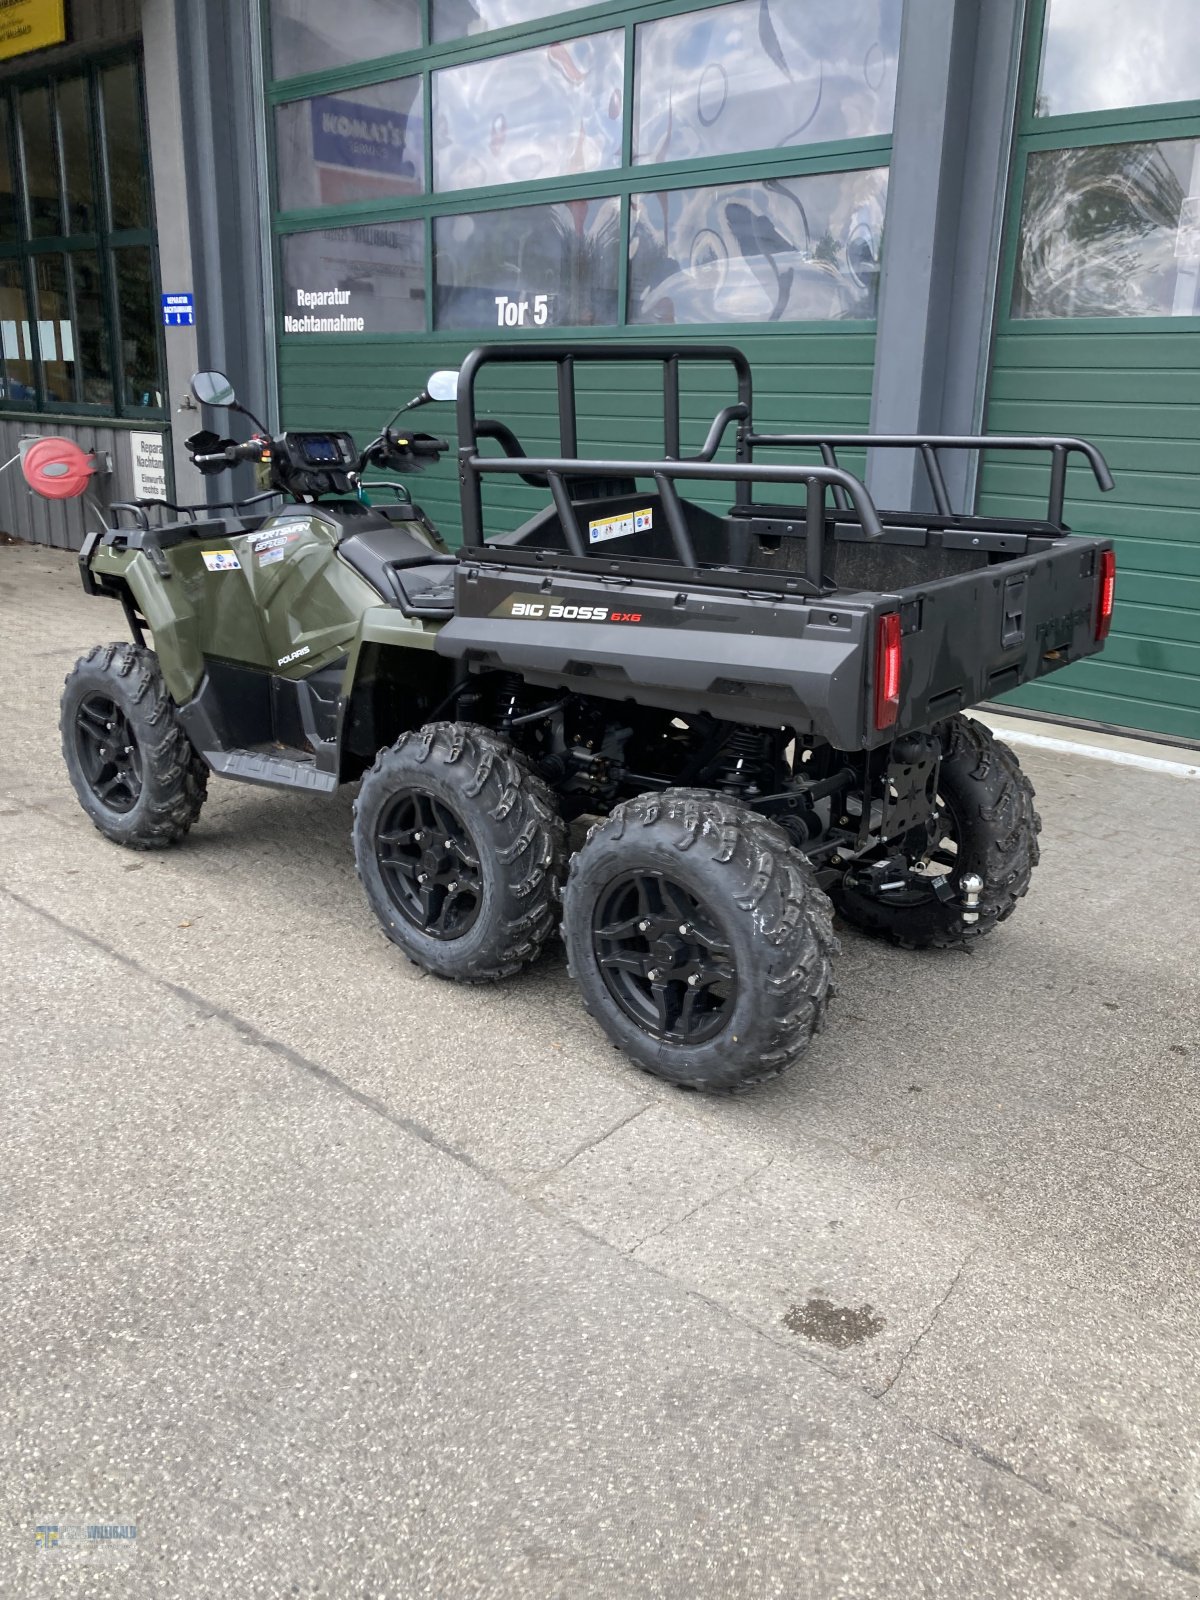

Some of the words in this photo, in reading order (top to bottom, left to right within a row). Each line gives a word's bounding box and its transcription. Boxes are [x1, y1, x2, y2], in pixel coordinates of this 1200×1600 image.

[296, 287, 351, 310] Reparatur
[494, 296, 529, 327] Tor
[533, 294, 548, 326] 5
[283, 313, 365, 333] Nachtannahme
[246, 522, 311, 543] SPORTSMAN
[511, 603, 545, 617] BIG
[548, 605, 609, 621] BOSS
[277, 645, 310, 667] POLARIS
